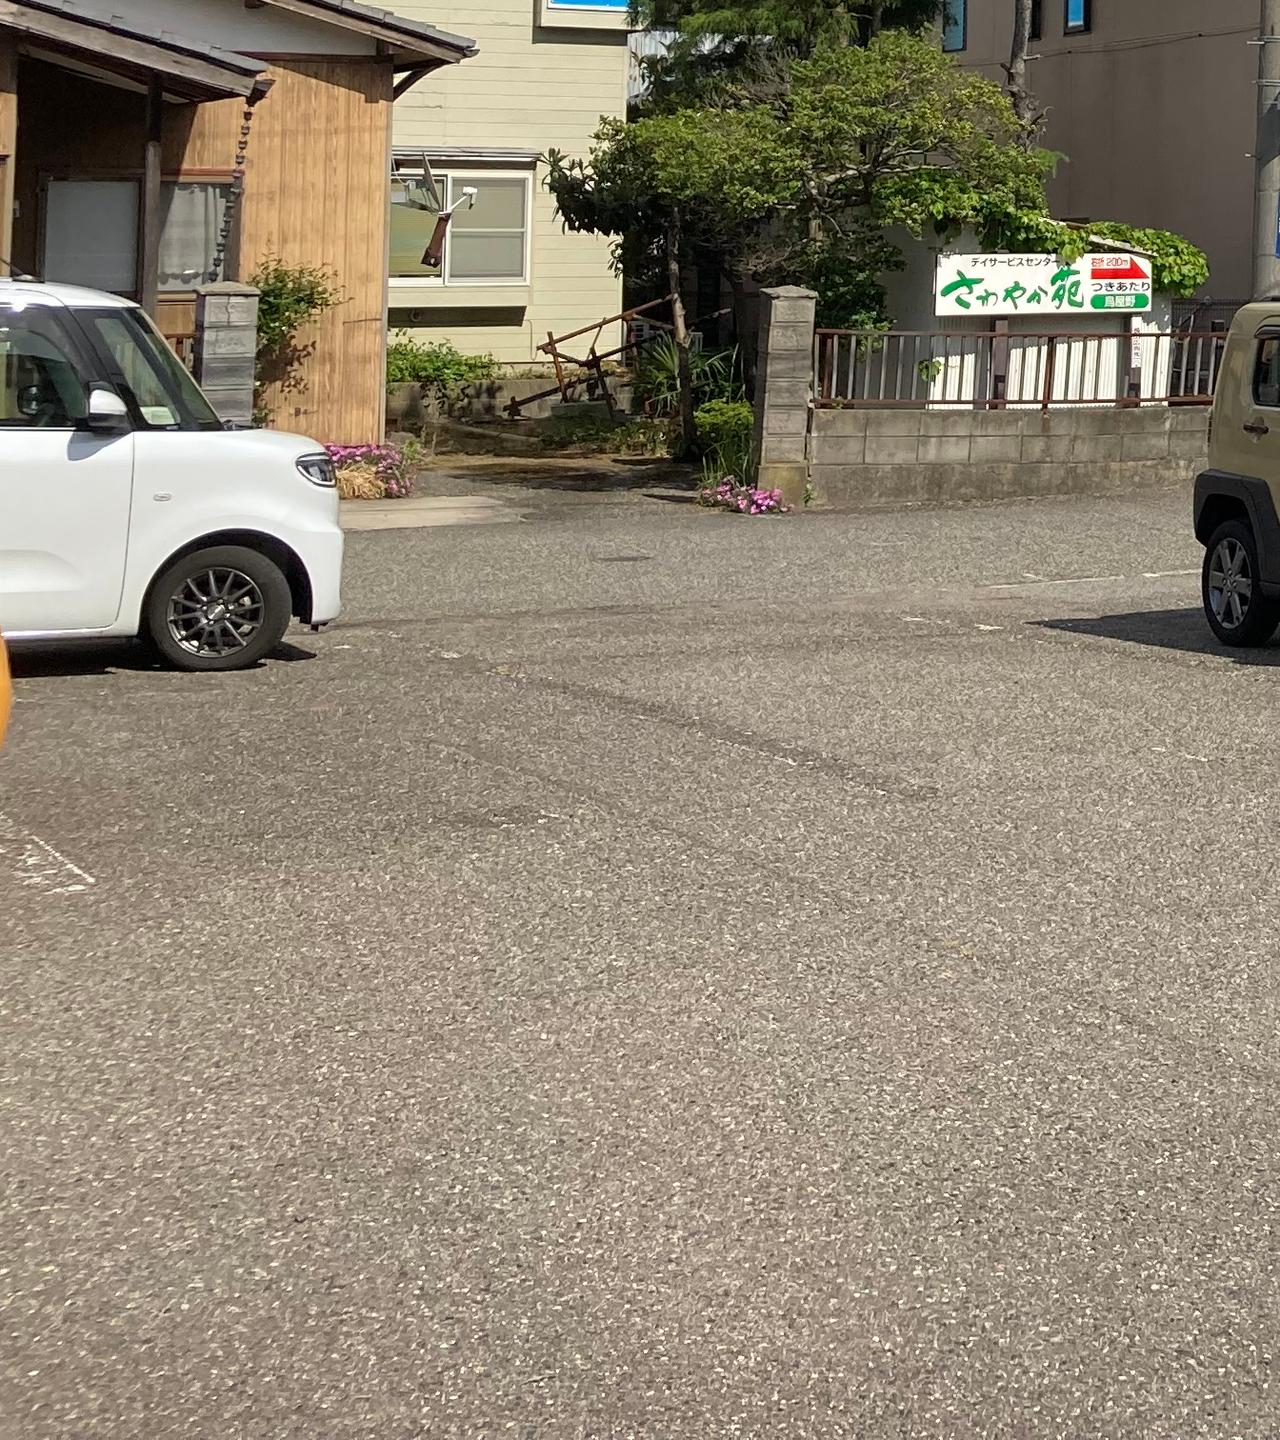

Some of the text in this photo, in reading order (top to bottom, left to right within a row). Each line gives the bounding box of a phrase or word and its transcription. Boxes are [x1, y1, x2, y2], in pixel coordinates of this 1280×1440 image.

[971, 257, 1061, 267] デイサービスセンター
[940, 265, 1084, 309] さわやか苑
[1091, 281, 1150, 292] つきあたり
